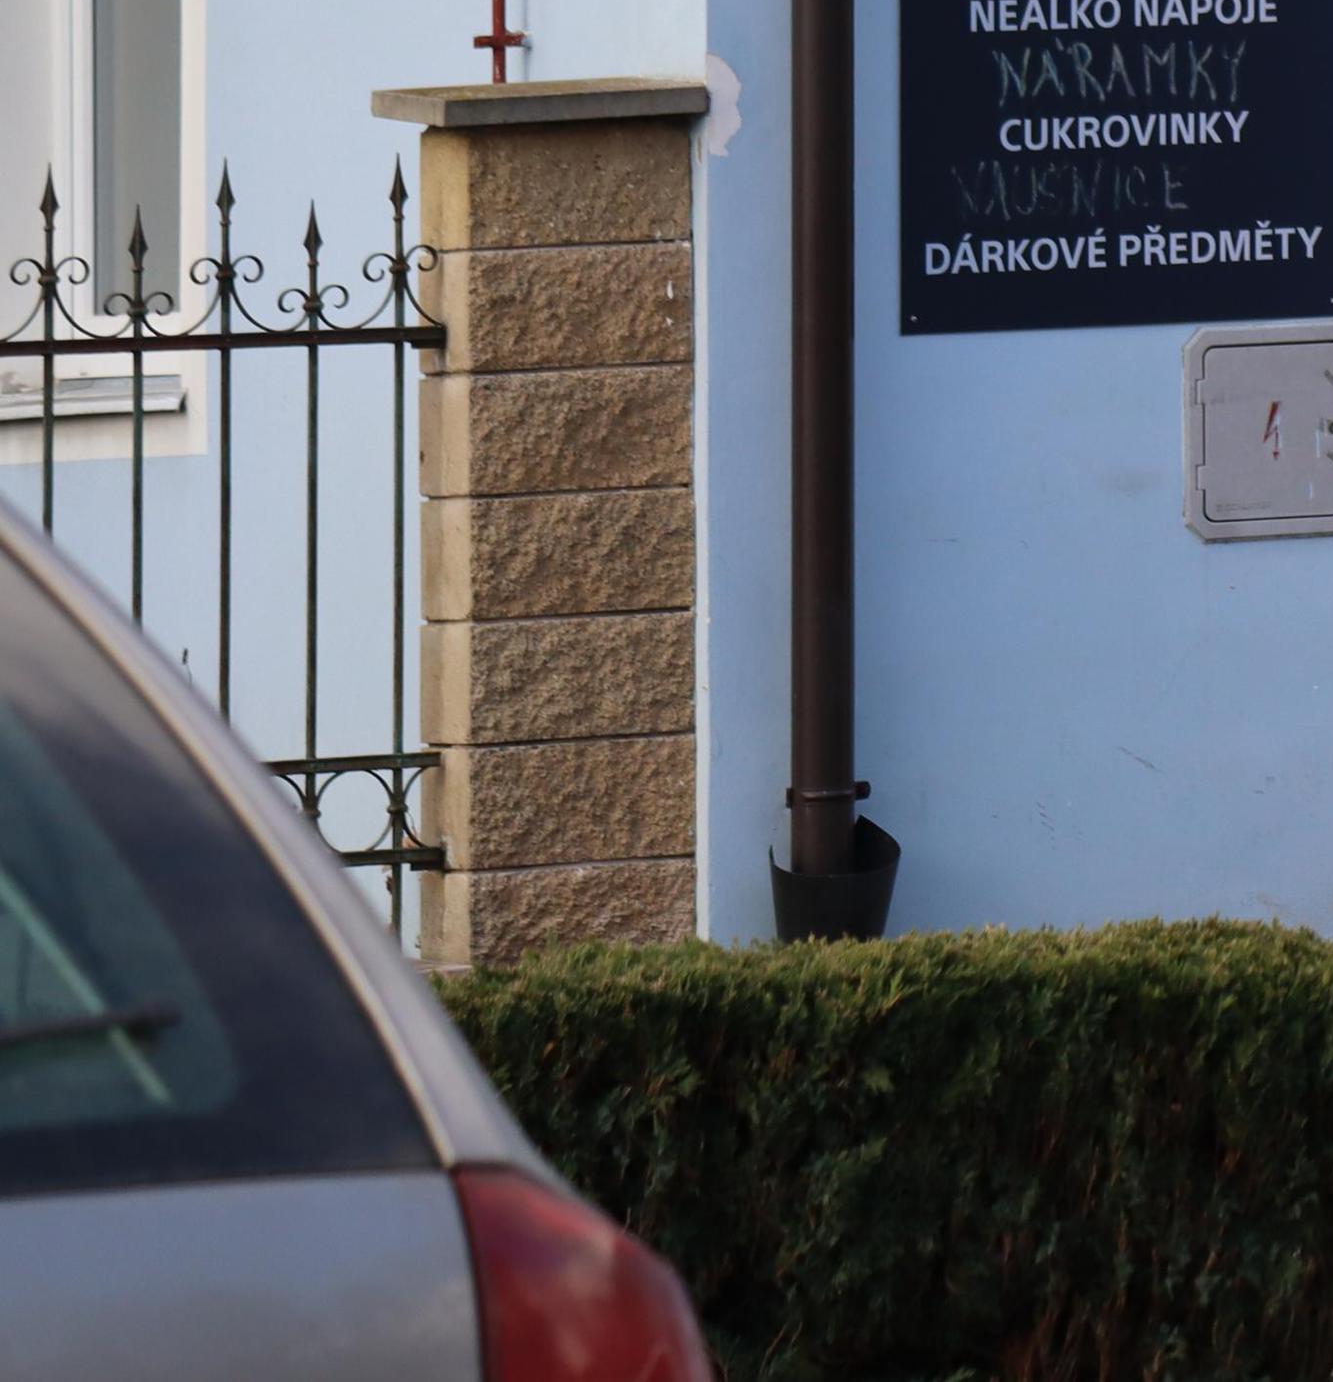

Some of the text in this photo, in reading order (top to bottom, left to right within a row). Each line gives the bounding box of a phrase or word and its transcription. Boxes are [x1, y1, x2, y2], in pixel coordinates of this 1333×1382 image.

[999, 110, 1249, 152] CUKROVINKY
[925, 220, 1323, 276] DÁRKOVÉ PŘEDMĚTY
